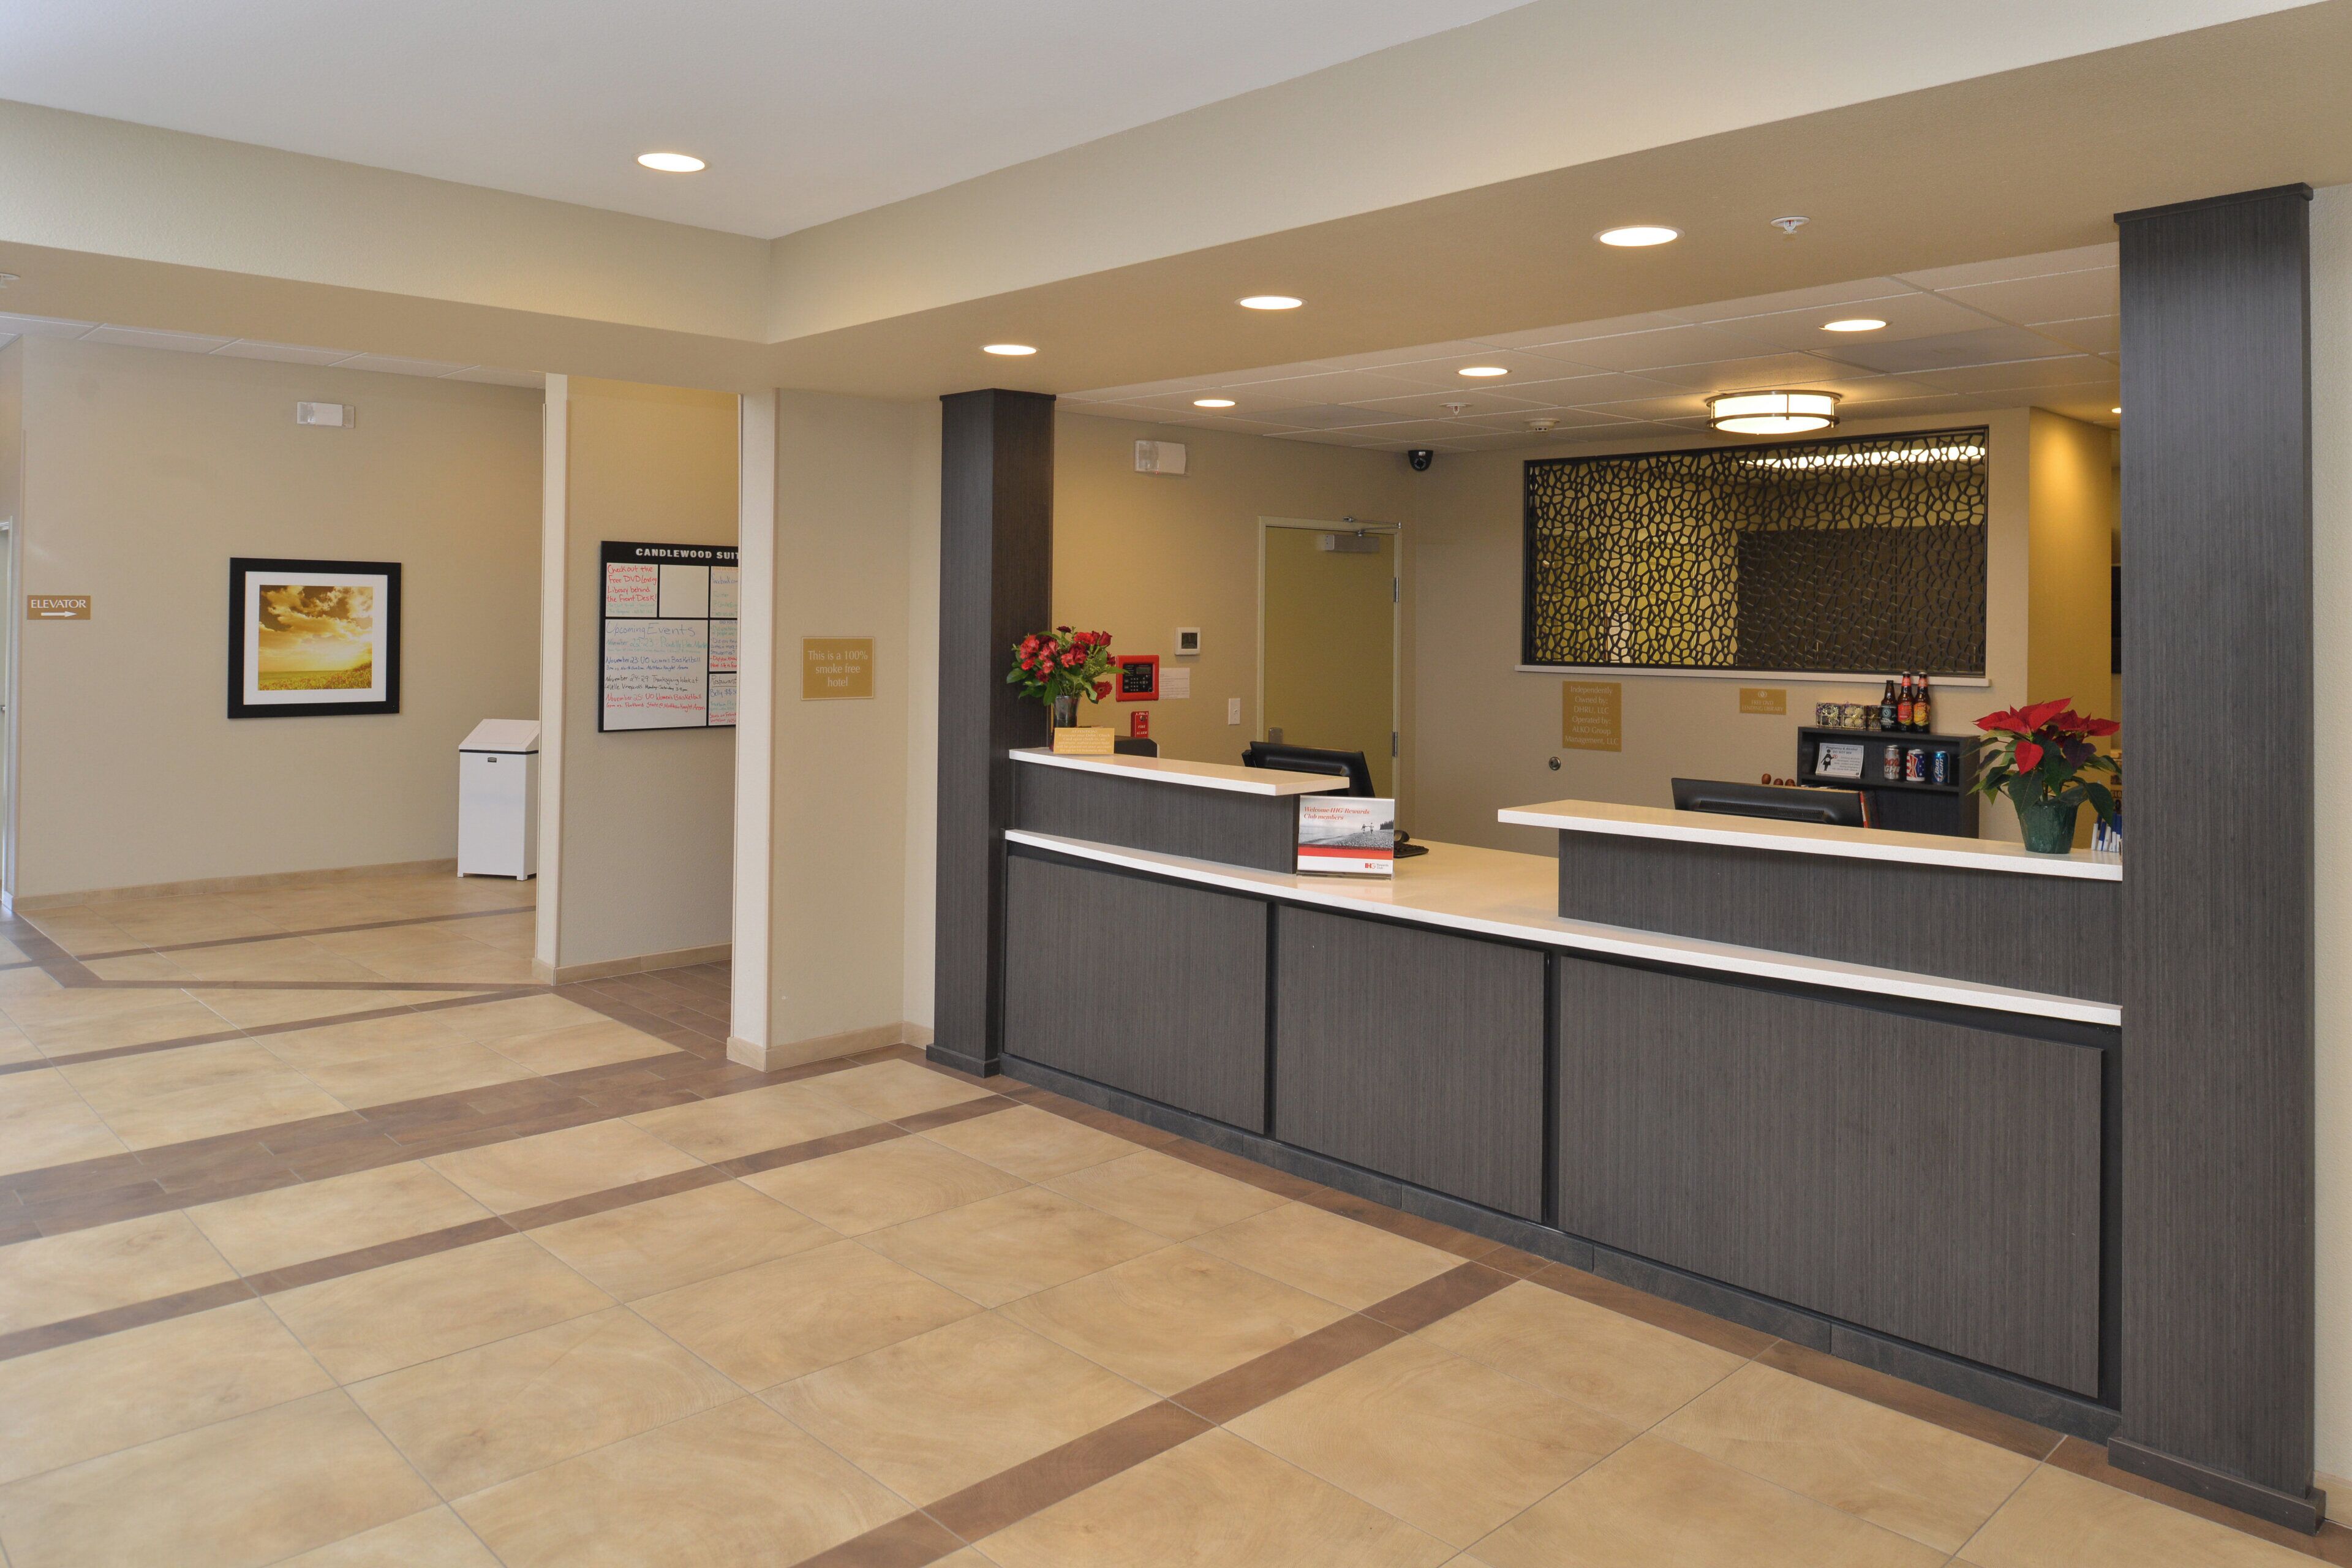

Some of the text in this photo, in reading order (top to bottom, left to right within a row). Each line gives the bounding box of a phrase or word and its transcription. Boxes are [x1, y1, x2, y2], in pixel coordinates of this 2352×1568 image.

[636, 548, 712, 559] CANDLEWOOD
[608, 575, 622, 584] Free
[31, 599, 86, 608] ELEVATOR
[606, 621, 696, 639] Upcoming Events
[807, 650, 825, 660] This
[827, 650, 834, 660] is
[844, 650, 868, 660] 100%
[815, 663, 861, 674] smoke free
[827, 676, 848, 687] hotel
[1570, 686, 1613, 696] Independently
[1599, 696, 1608, 706] by:
[1572, 716, 1600, 725] Operated
[1591, 726, 1611, 736] Group
[1565, 735, 1605, 745] Management,
